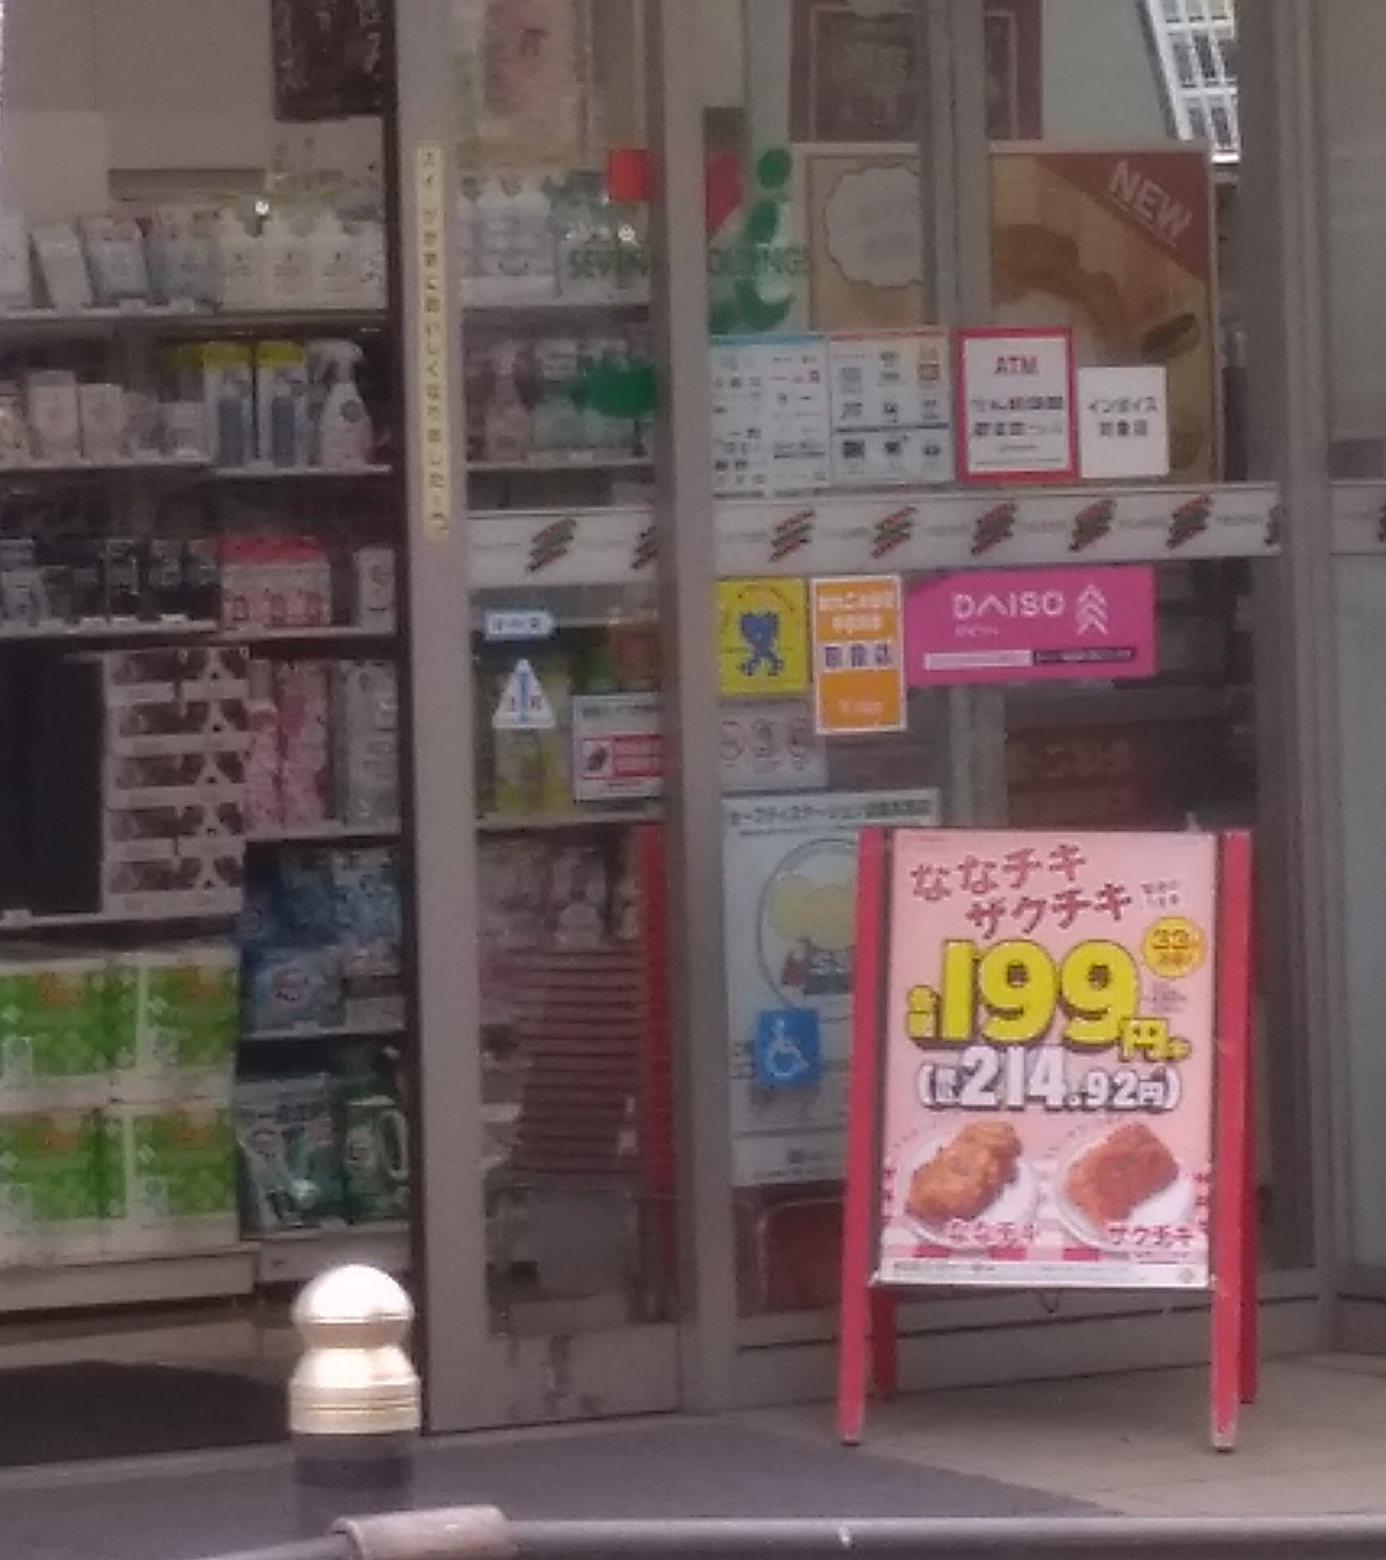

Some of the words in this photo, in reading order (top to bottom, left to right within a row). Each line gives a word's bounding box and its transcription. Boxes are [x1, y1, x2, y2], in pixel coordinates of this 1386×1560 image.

[1107, 161, 1194, 237] NEW
[992, 356, 1039, 376] ATM
[952, 590, 1067, 620] DAISO
[909, 843, 1087, 902] ななチキ
[964, 882, 1133, 940] ザクチキ
